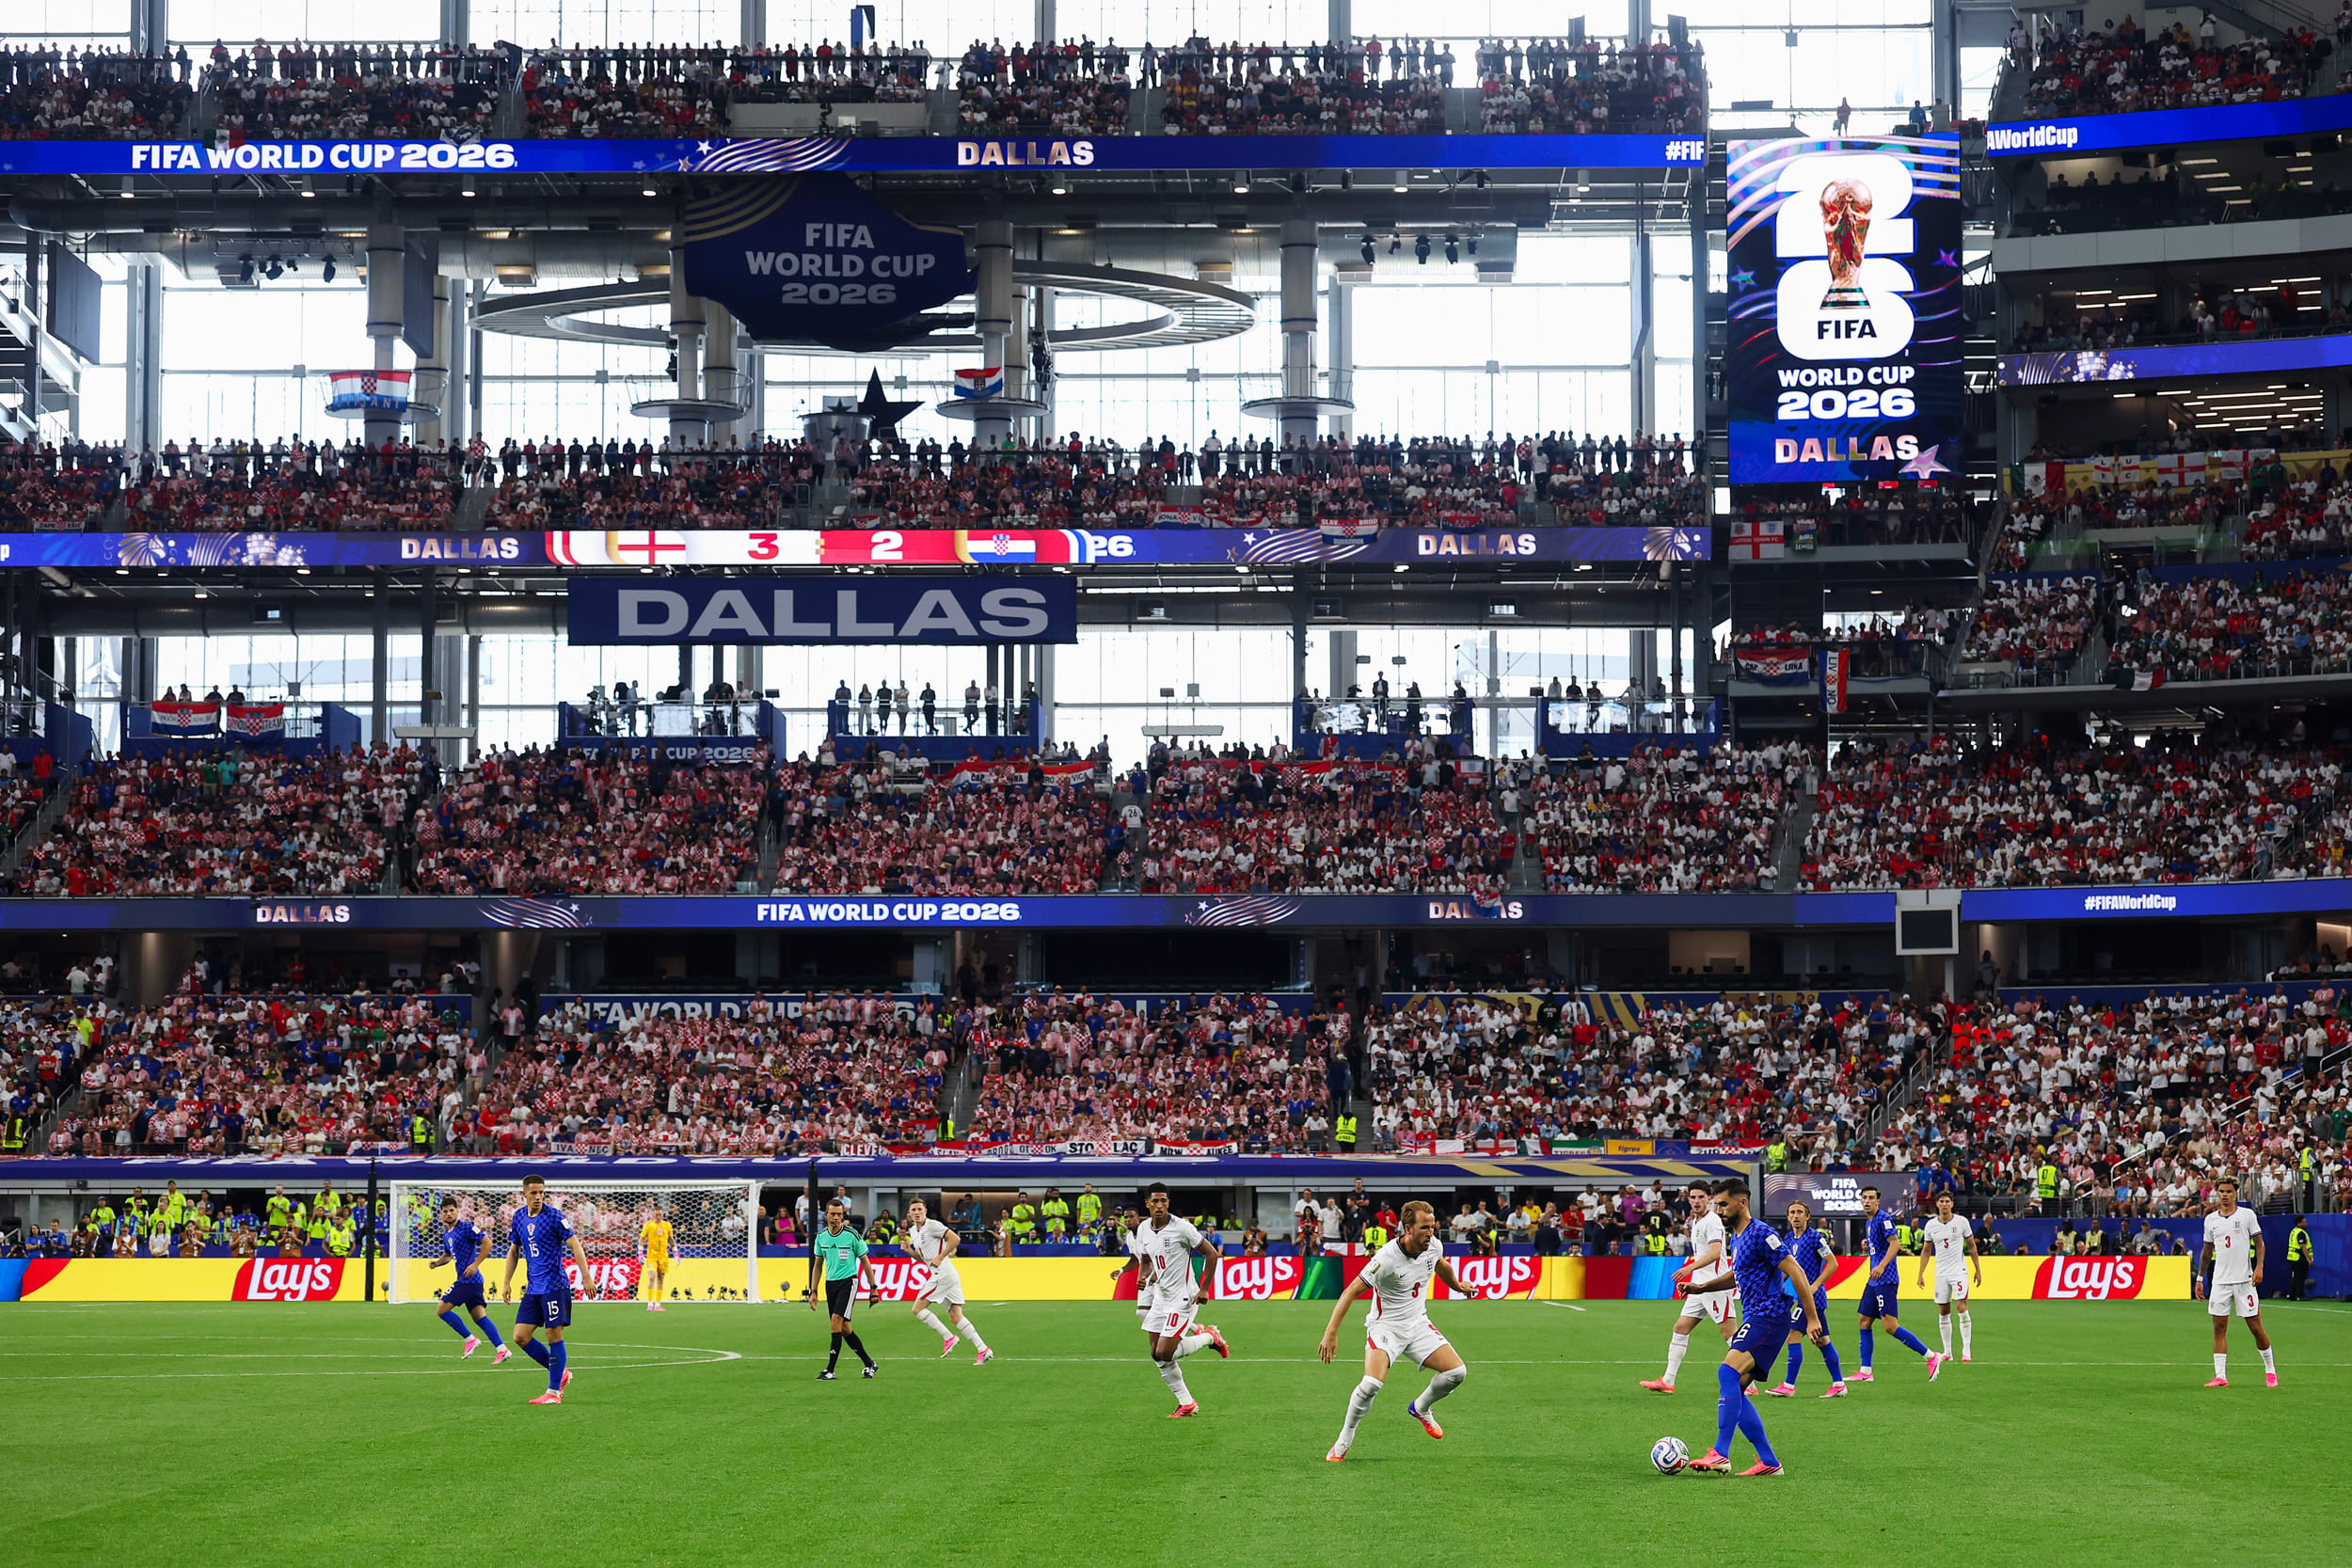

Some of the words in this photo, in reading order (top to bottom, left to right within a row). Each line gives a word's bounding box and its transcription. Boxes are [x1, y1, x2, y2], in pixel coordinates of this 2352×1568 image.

[132, 145, 201, 169] FIFA
[206, 145, 325, 169] WORLD
[329, 144, 395, 169] CUP
[400, 143, 515, 168] 2026
[958, 141, 1094, 166] DALLAS
[805, 223, 875, 248] FIFA
[745, 250, 865, 277] WORLD
[870, 253, 936, 278] CUP
[782, 282, 897, 306] 2026
[1818, 319, 1877, 340] FIFA
[1776, 367, 1864, 388] WORLD
[1867, 365, 1915, 386] CUP
[1776, 387, 1916, 420] 2026
[1774, 435, 1919, 464] DALLAS
[401, 537, 519, 560] DALLAS
[748, 533, 780, 561] 3
[870, 531, 903, 561] 2
[1418, 533, 1537, 556] DALLAS
[618, 587, 1050, 638] DALLAS
[666, 748, 698, 760] CUP
[1127, 809, 1137, 818] 26
[2085, 894, 2177, 911] #FIFAWorldCup
[256, 905, 351, 923] DALLAS
[756, 904, 805, 922] FIFA
[807, 904, 890, 922] WORLD
[892, 903, 938, 922] CUP
[941, 902, 1021, 922] 2026
[556, 1144, 574, 1153] IVA
[1069, 1142, 1094, 1153] STO
[1113, 1142, 1137, 1153] LAC
[1831, 1178, 1858, 1189] FIFA
[1811, 1189, 1854, 1200] WORLD
[529, 1243, 540, 1258] 15
[1943, 1238, 1949, 1249] 5
[2225, 1235, 2232, 1248] 3
[1155, 1255, 1167, 1270] 10
[247, 1258, 333, 1302] Lay's
[564, 1258, 631, 1301] ay's
[1957, 1281, 1963, 1291] 5
[2047, 1256, 2135, 1300] Lay's
[548, 1301, 560, 1316] 15
[1712, 1300, 1720, 1314] 4
[2247, 1294, 2254, 1307] 3
[1166, 1313, 1179, 1327] 10
[1736, 1323, 1751, 1338] 6
